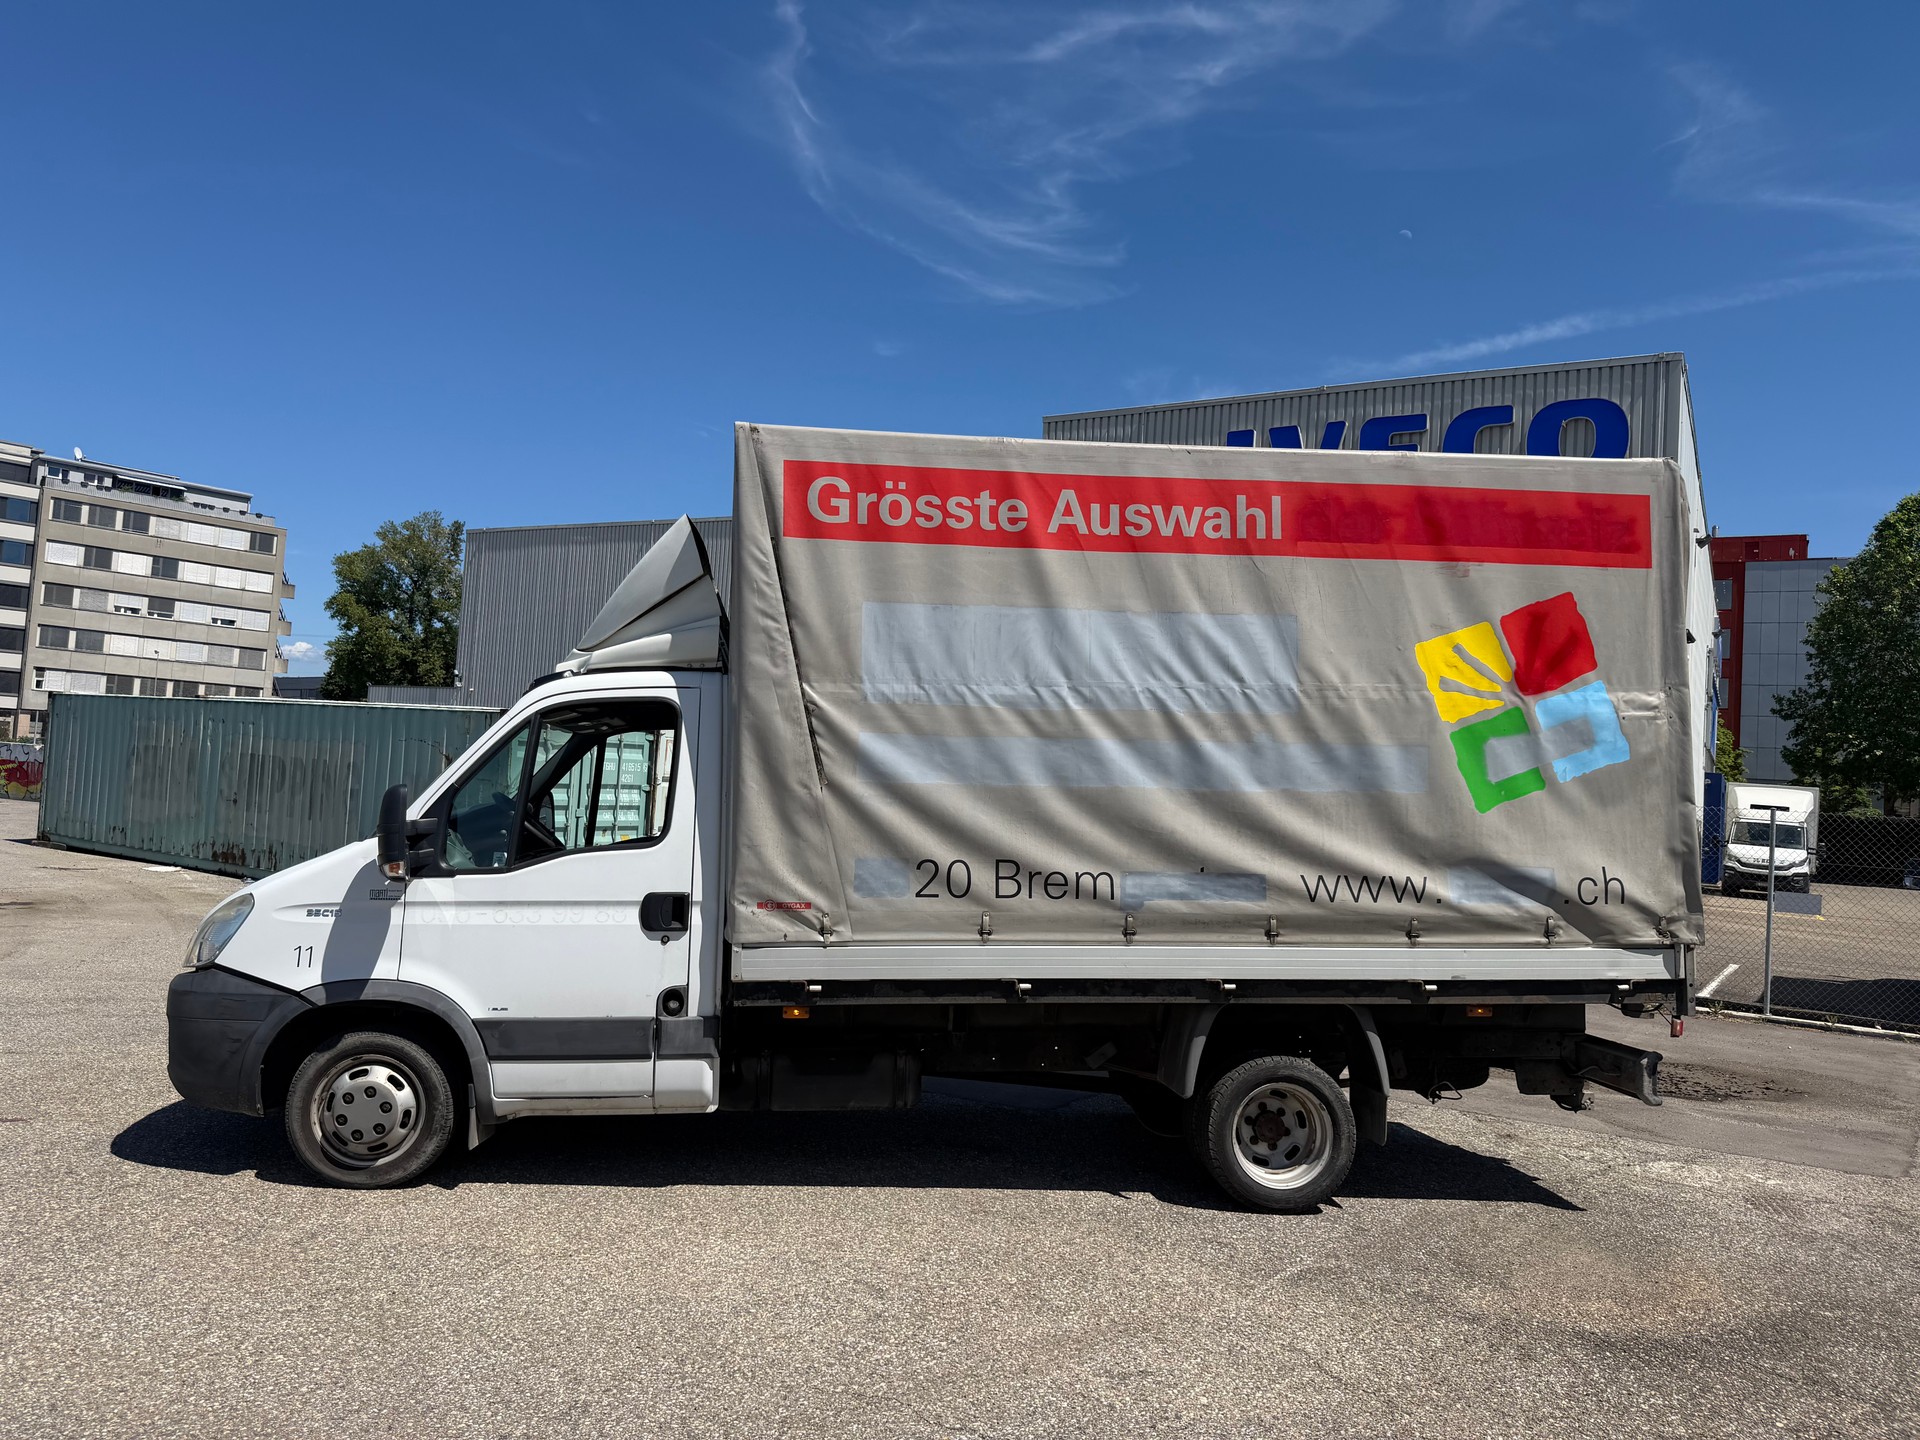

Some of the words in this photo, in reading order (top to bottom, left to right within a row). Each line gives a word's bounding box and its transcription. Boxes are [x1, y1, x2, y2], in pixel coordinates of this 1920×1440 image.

[806, 475, 1029, 532] Grösste
[1046, 489, 1282, 540] Auswahl
[914, 859, 973, 899] 20
[994, 859, 1116, 900] Brem
[293, 945, 313, 968] 11
